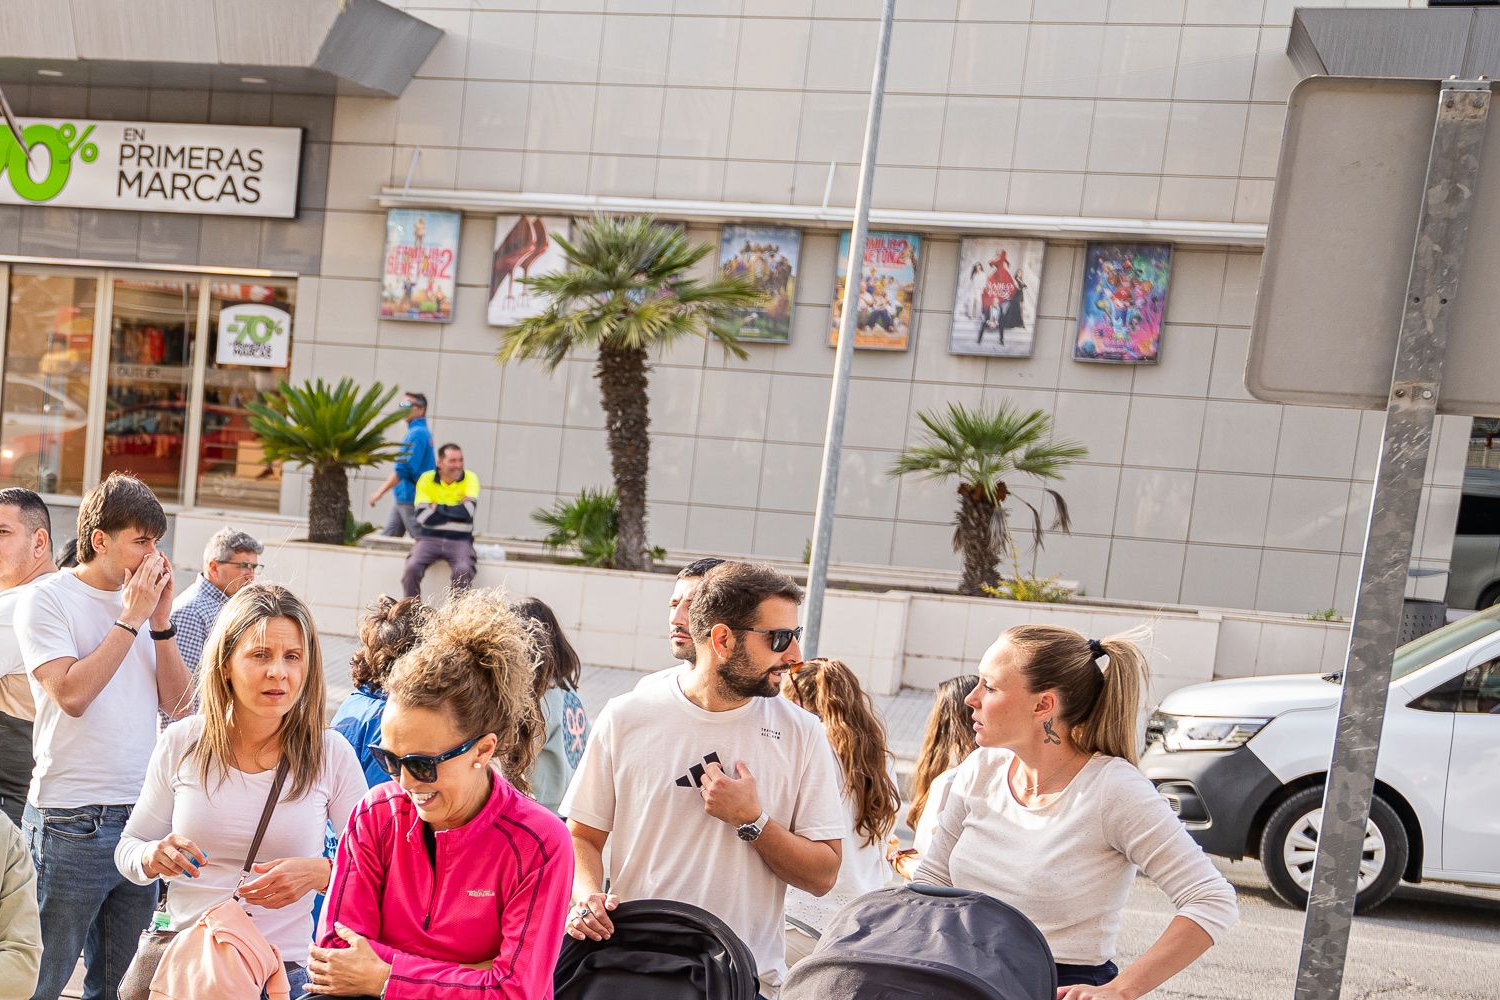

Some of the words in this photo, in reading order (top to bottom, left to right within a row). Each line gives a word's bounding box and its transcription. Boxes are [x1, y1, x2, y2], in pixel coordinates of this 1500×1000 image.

[123, 127, 146, 142] EN
[119, 143, 264, 174] PRIMERAS
[116, 169, 261, 204] MARCAS
